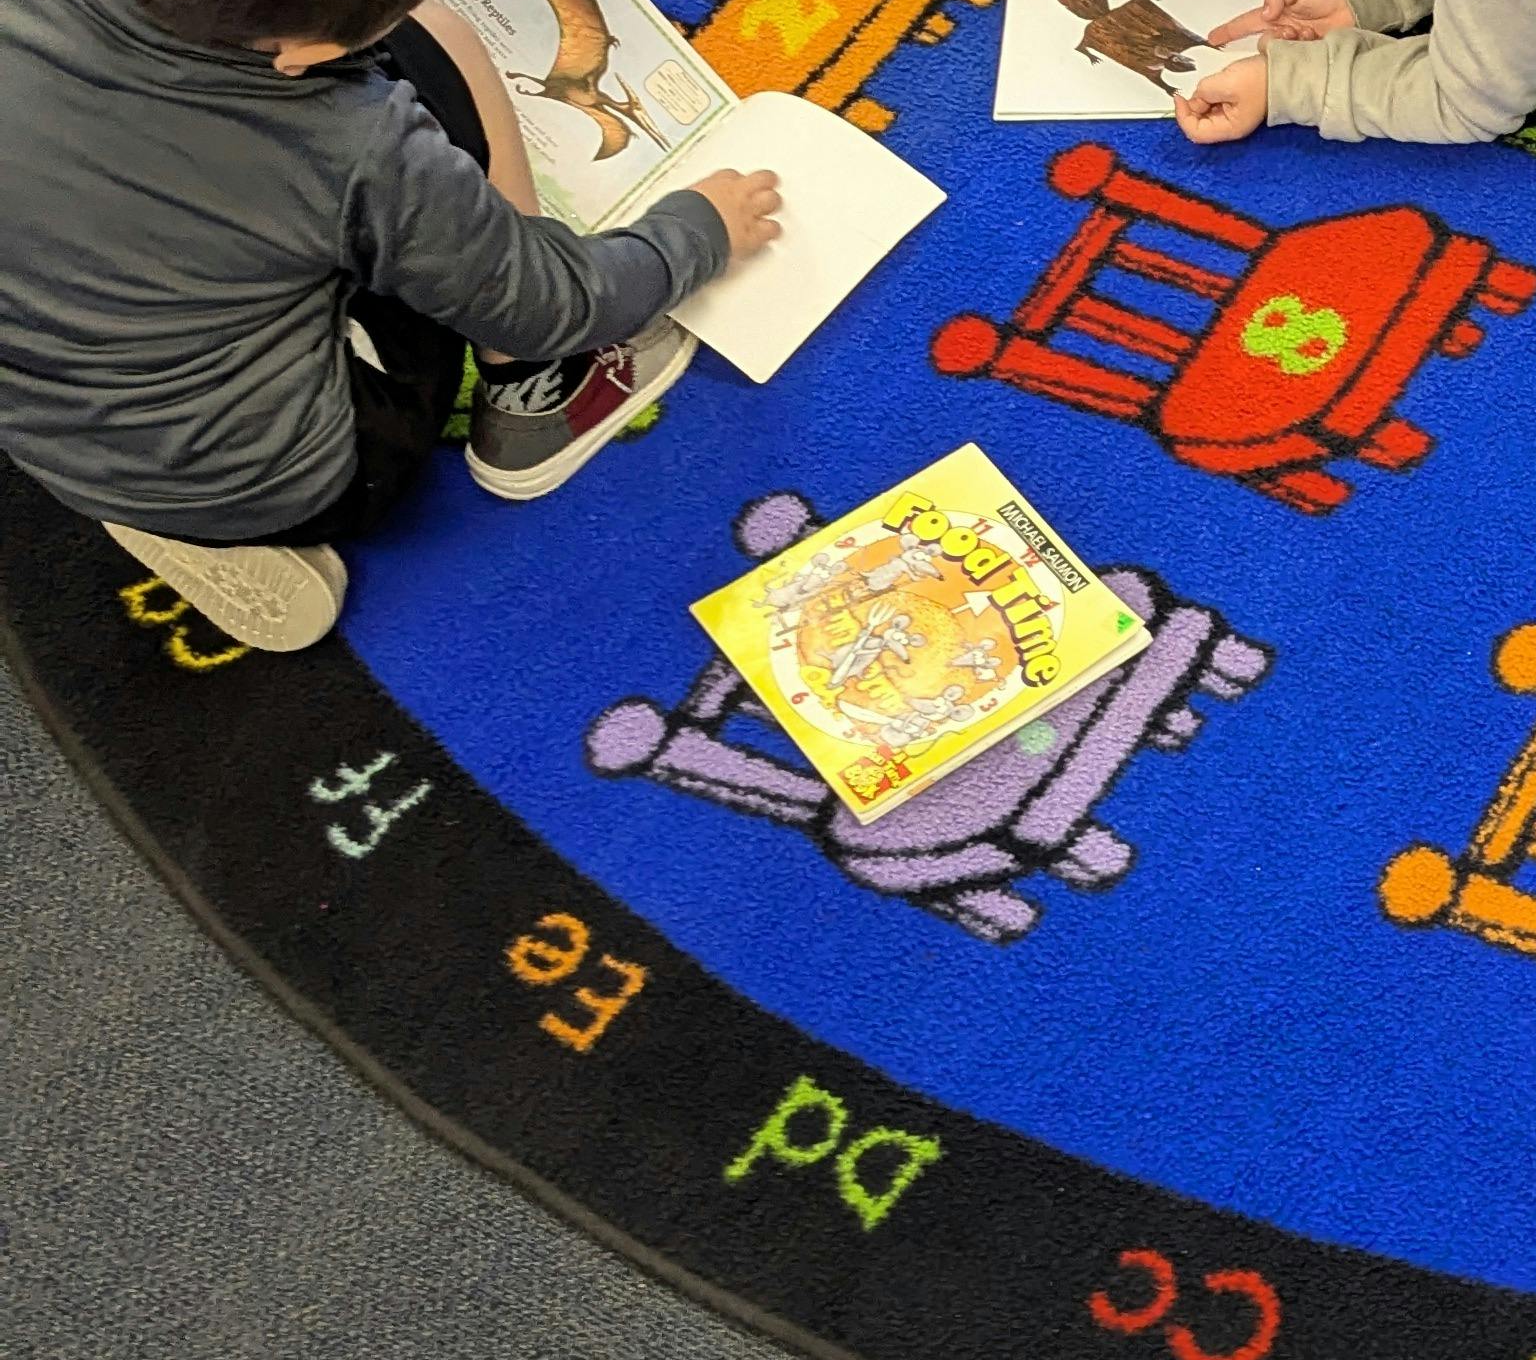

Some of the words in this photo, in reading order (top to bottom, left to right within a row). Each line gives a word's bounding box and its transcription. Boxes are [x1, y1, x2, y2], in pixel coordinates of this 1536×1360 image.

[1247, 301, 1340, 370] 8
[883, 491, 1012, 585] Food
[987, 562, 1062, 690] Time
[1000, 502, 1048, 554] MICHAEL
[1041, 543, 1087, 593] SALMON
[311, 753, 430, 858] Ff
[508, 913, 645, 1051] Ee
[725, 1076, 941, 1230] Dd
